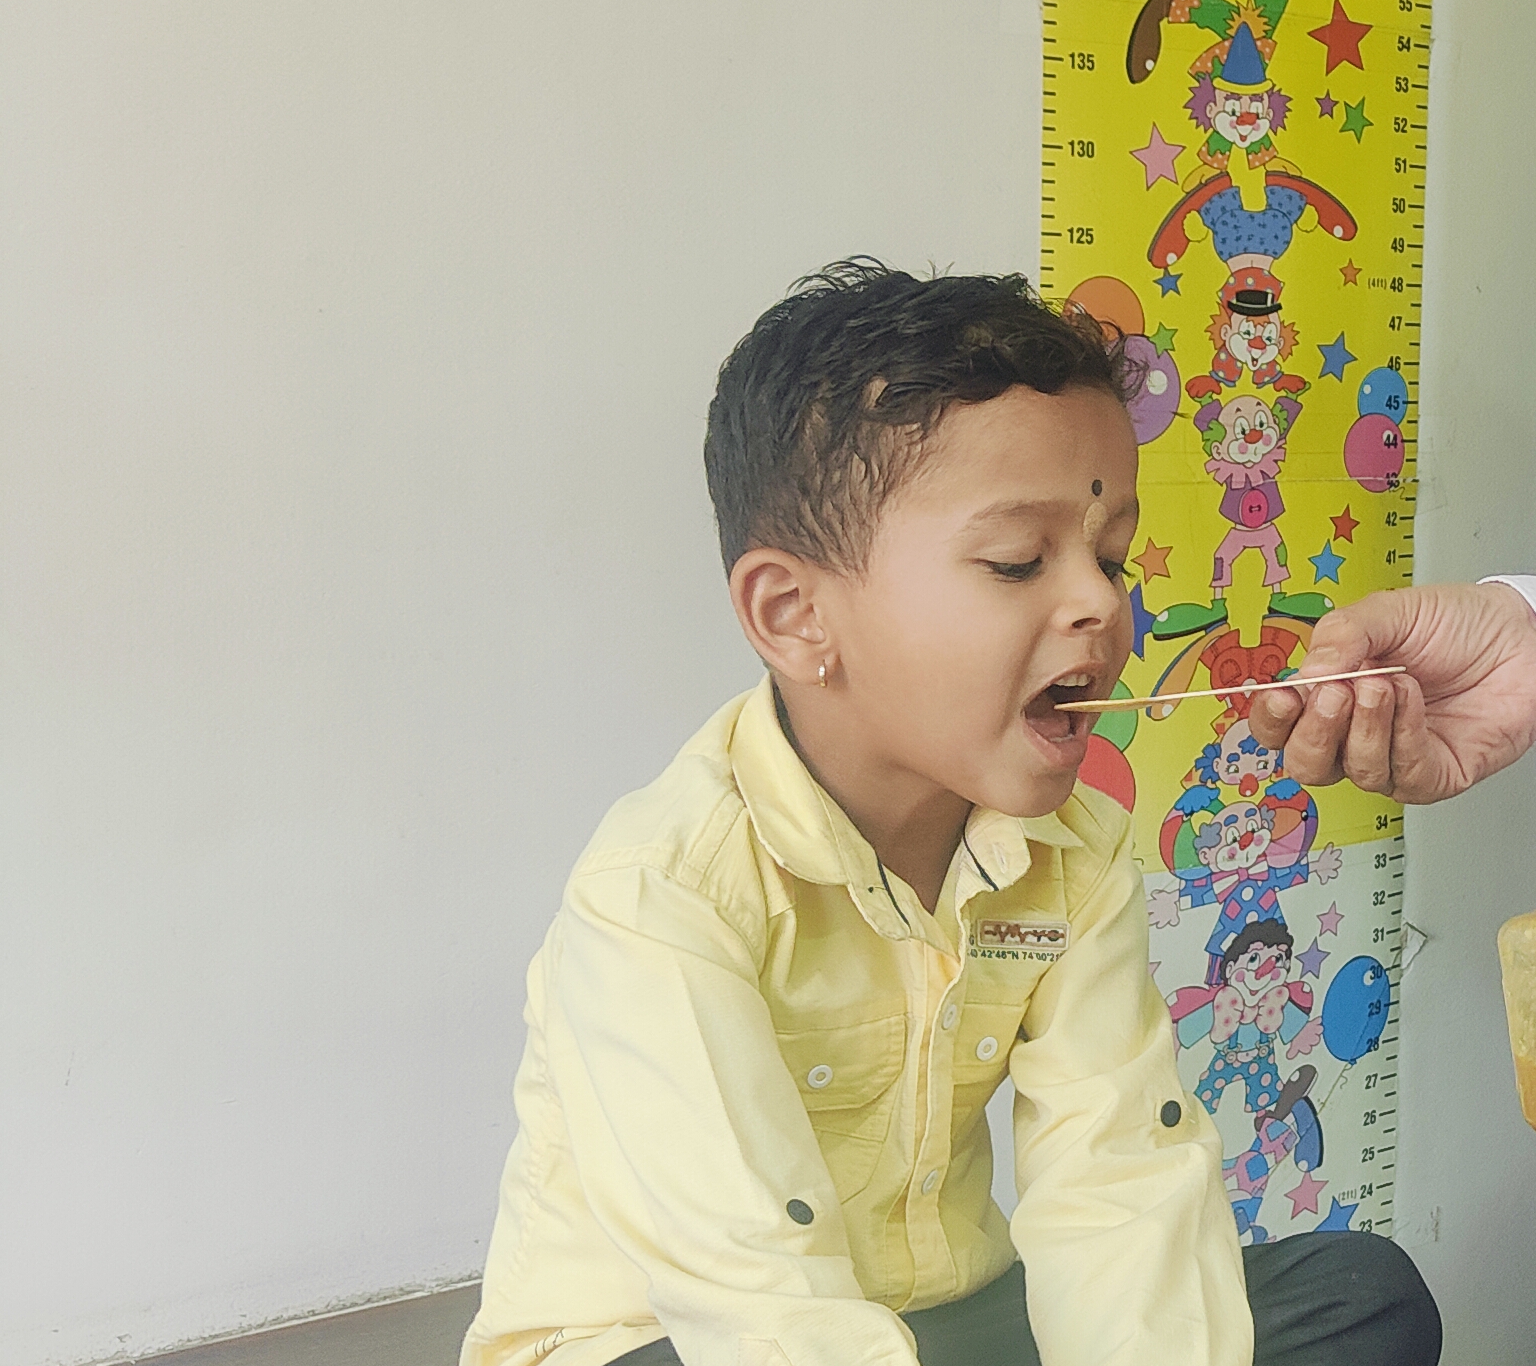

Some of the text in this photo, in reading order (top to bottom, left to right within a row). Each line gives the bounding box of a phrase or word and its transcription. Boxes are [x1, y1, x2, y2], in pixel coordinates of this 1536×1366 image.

[1398, 36, 1410, 52] 54
[1069, 53, 1094, 71] 135
[1395, 77, 1408, 93] 53
[1394, 117, 1407, 133] 52
[1068, 140, 1094, 158] 130
[1395, 158, 1406, 173] 51
[1392, 198, 1405, 213] 50
[1067, 227, 1093, 244] 125
[1391, 238, 1404, 253] 49
[1390, 277, 1403, 292] 48
[1389, 316, 1402, 331] 47
[1387, 355, 1401, 371] 46
[1386, 395, 1399, 410] 45
[1384, 434, 1398, 449] 44
[1385, 512, 1397, 526] 42
[1386, 549, 1396, 565] 41
[1376, 815, 1388, 830] 34
[1375, 853, 1386, 869] 33
[1373, 890, 1385, 906] 32
[1373, 927, 1384, 943] 31
[1370, 965, 1383, 981] 30
[1368, 1001, 1381, 1017] 29
[1367, 1036, 1379, 1052] 28
[1365, 1073, 1378, 1089] 27
[1364, 1110, 1376, 1126] 26
[1362, 1146, 1374, 1163] 25
[1360, 1183, 1373, 1199] 24
